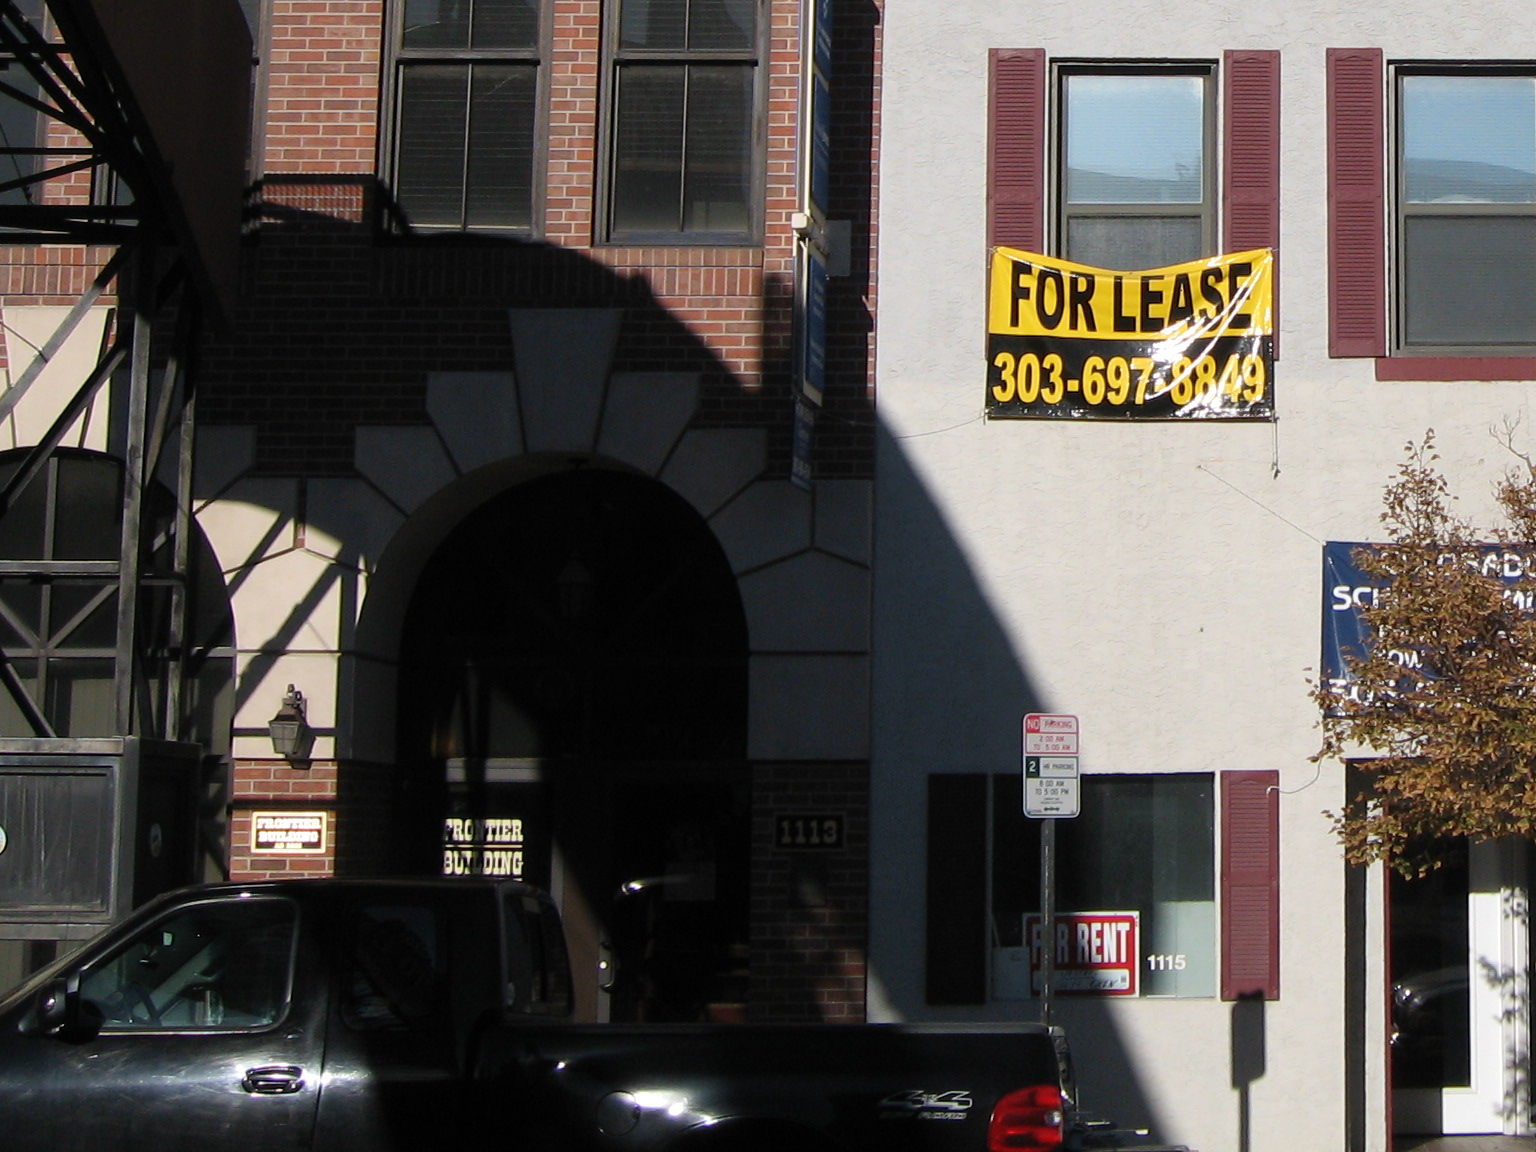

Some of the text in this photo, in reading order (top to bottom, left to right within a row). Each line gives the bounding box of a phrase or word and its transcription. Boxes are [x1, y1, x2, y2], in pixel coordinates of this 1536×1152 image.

[1010, 260, 1253, 333] FOR LEASE
[992, 352, 1265, 406] 303-697-8849
[1026, 718, 1073, 729] NO PARKING
[1028, 760, 1036, 773] 2
[780, 819, 838, 845] 1113
[1032, 922, 1130, 964] FR RENT
[1147, 954, 1187, 970] 1115
